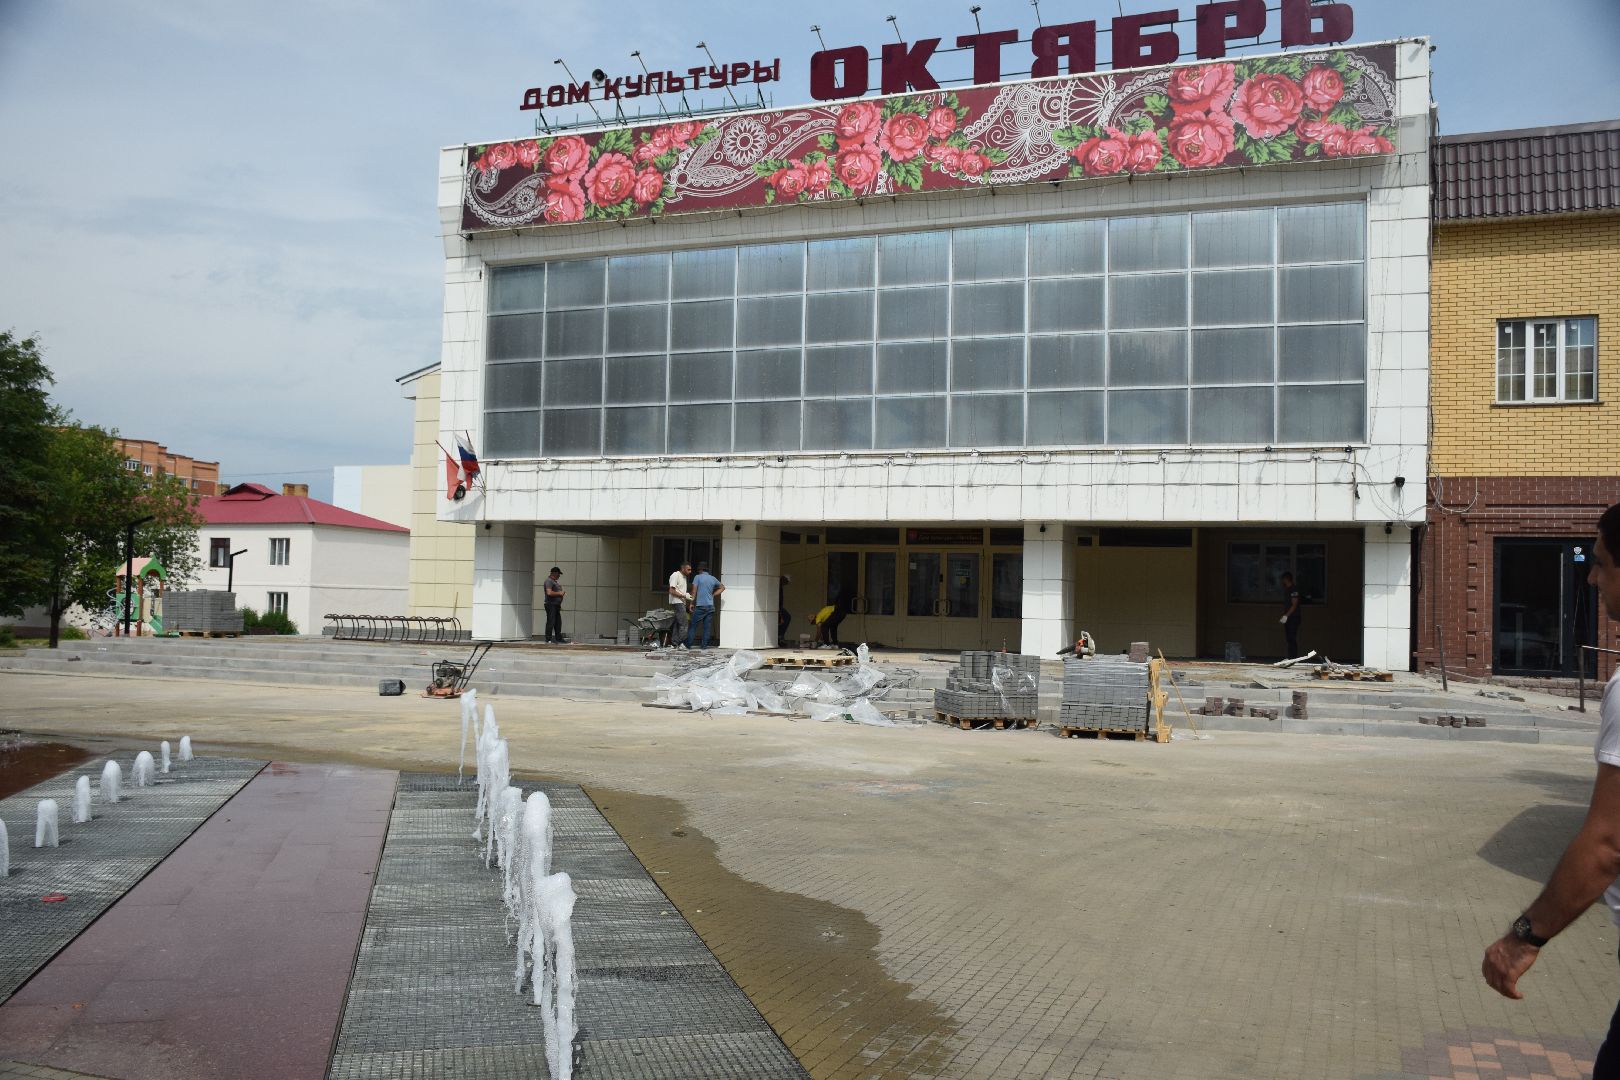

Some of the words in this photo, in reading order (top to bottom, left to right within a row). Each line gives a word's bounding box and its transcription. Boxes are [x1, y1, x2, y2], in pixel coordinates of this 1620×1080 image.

[519, 81, 590, 110] ДОМ
[604, 58, 780, 100] КУЛЬТУРЫ
[810, 0, 1354, 101] ОКТЯБРЬ
